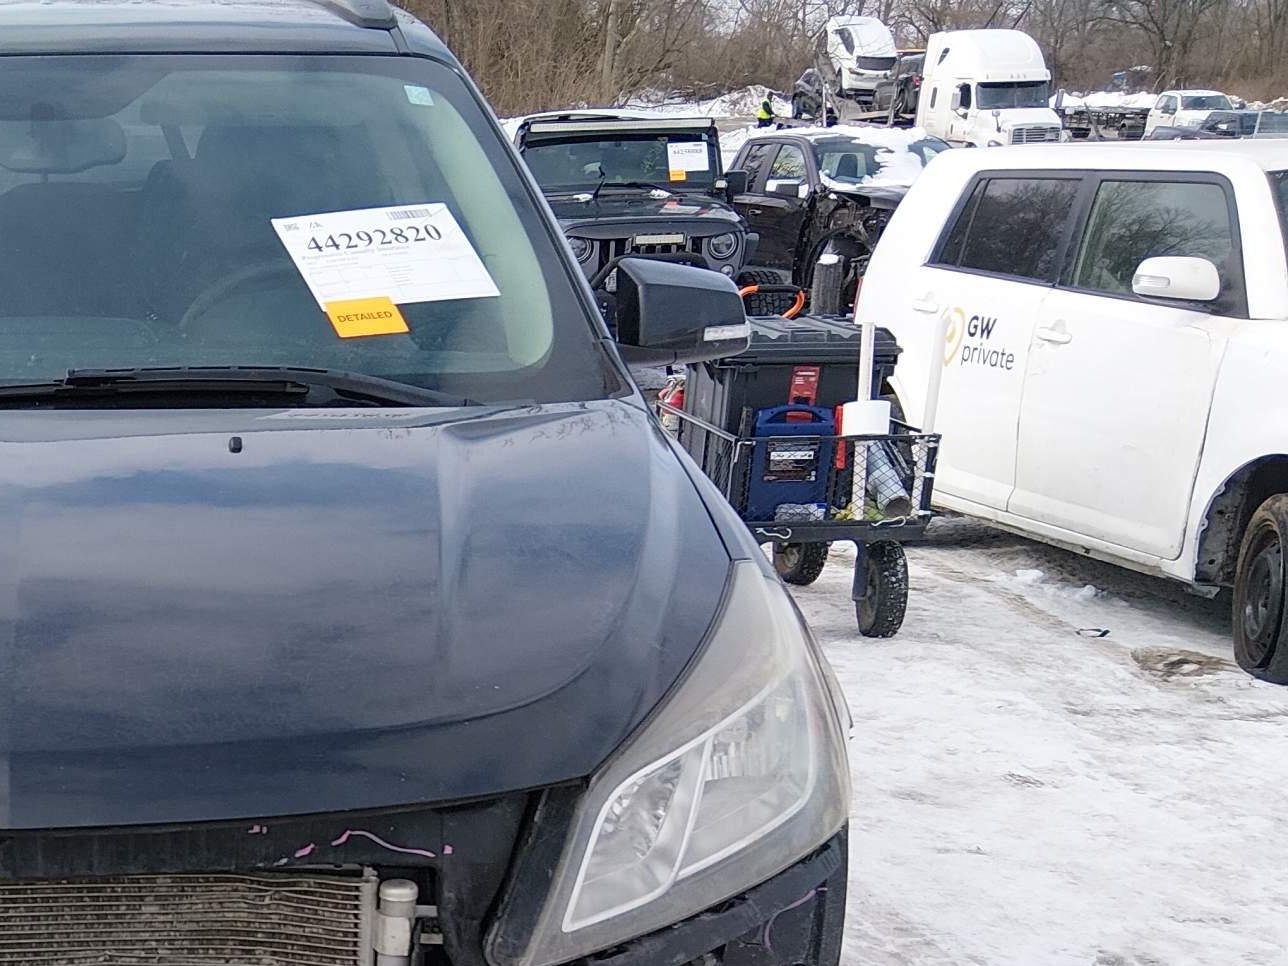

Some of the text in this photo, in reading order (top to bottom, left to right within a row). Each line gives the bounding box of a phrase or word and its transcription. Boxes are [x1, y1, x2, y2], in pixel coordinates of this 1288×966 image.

[307, 224, 442, 252] 44292820
[337, 311, 393, 323] DETAILED
[968, 315, 998, 340] GW
[961, 342, 1015, 370] private
